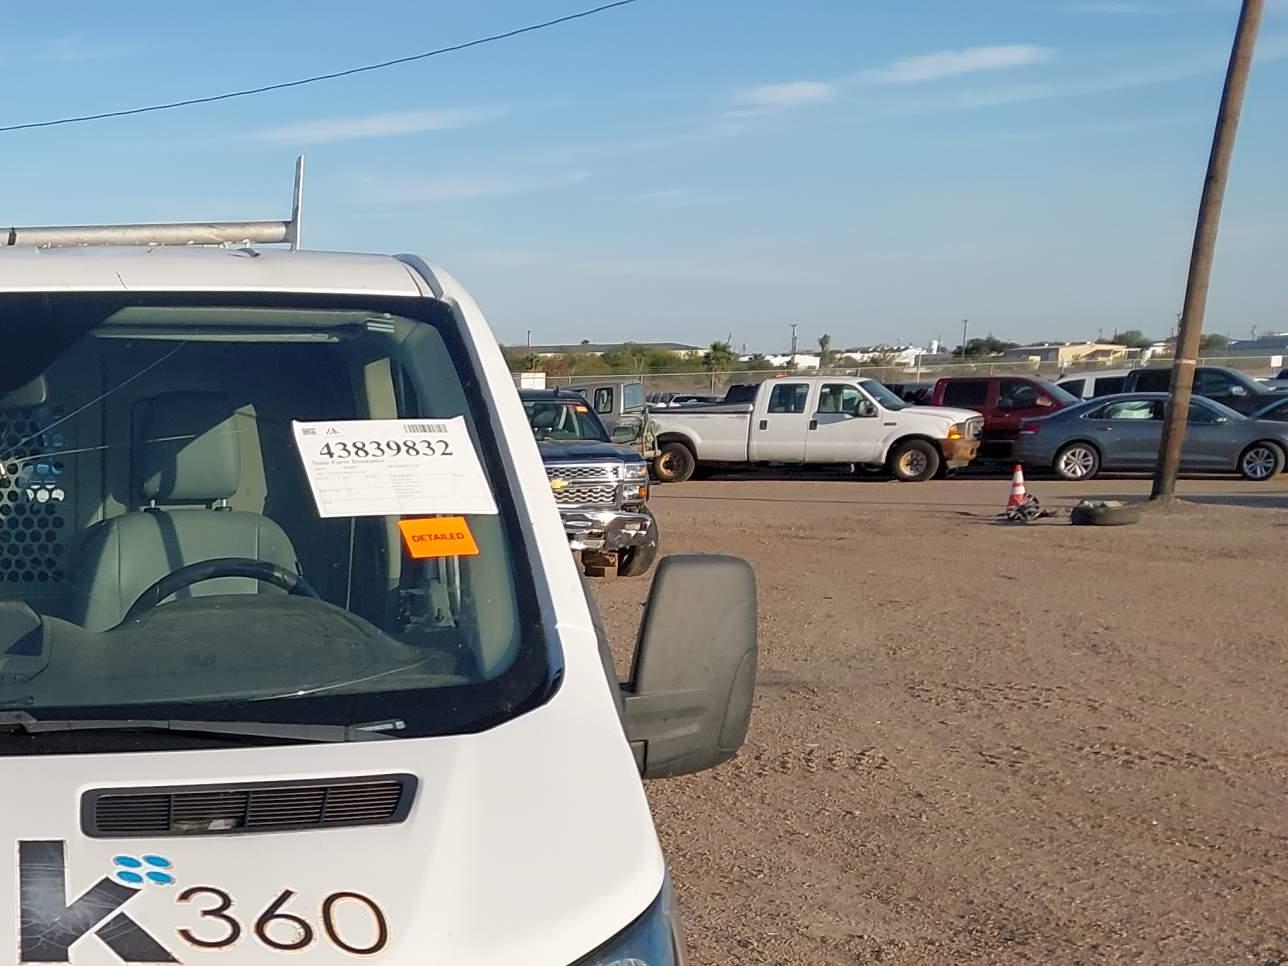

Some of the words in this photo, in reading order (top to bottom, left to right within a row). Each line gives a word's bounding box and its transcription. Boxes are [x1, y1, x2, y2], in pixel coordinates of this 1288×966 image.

[319, 439, 453, 459] 43839832
[412, 532, 465, 543] DETAILED
[177, 886, 389, 956] 360
